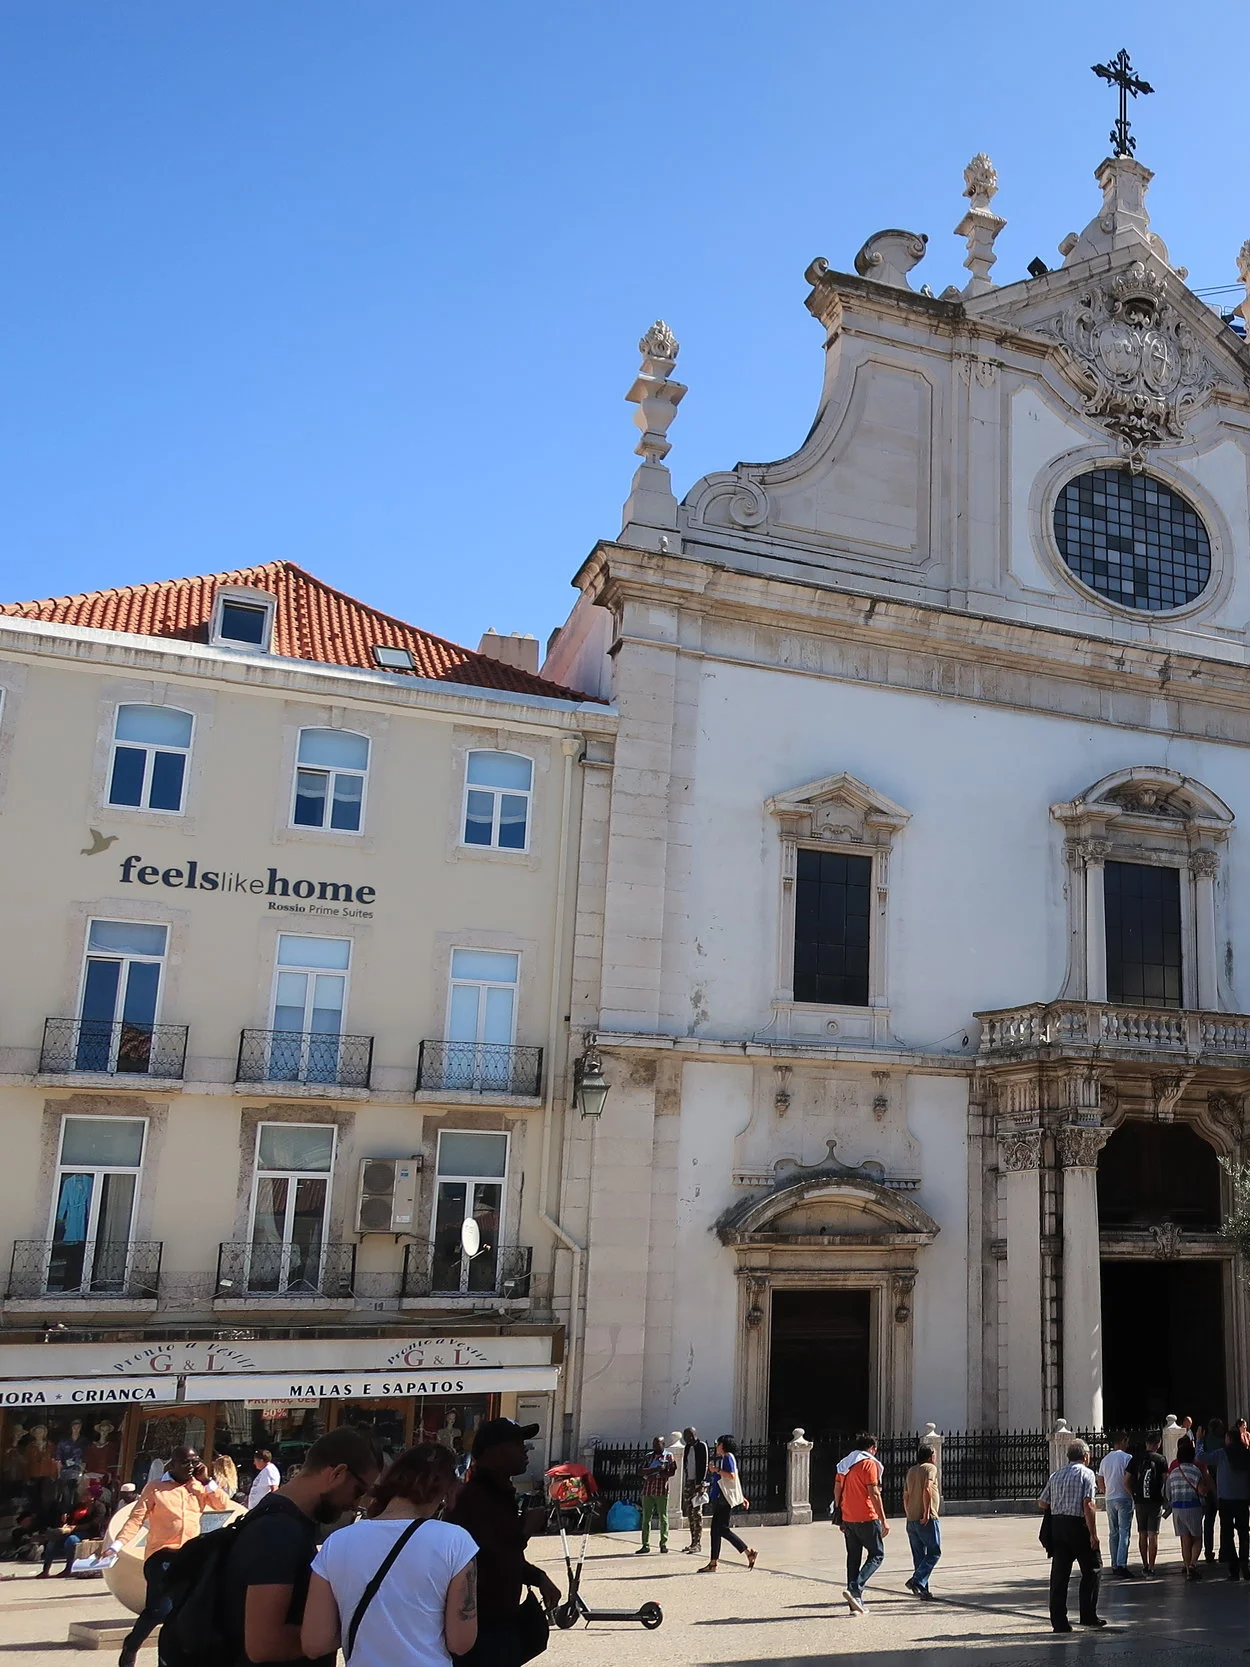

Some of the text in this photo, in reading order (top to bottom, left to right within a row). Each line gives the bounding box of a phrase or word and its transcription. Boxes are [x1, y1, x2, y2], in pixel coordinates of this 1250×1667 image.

[267, 901, 374, 919] Rossio Prime Suites
[149, 1353, 225, 1372] G & L
[403, 1349, 471, 1367] G & L
[289, 1380, 464, 1397] MALAS E SAPATOS
[0, 1391, 46, 1405] ORA
